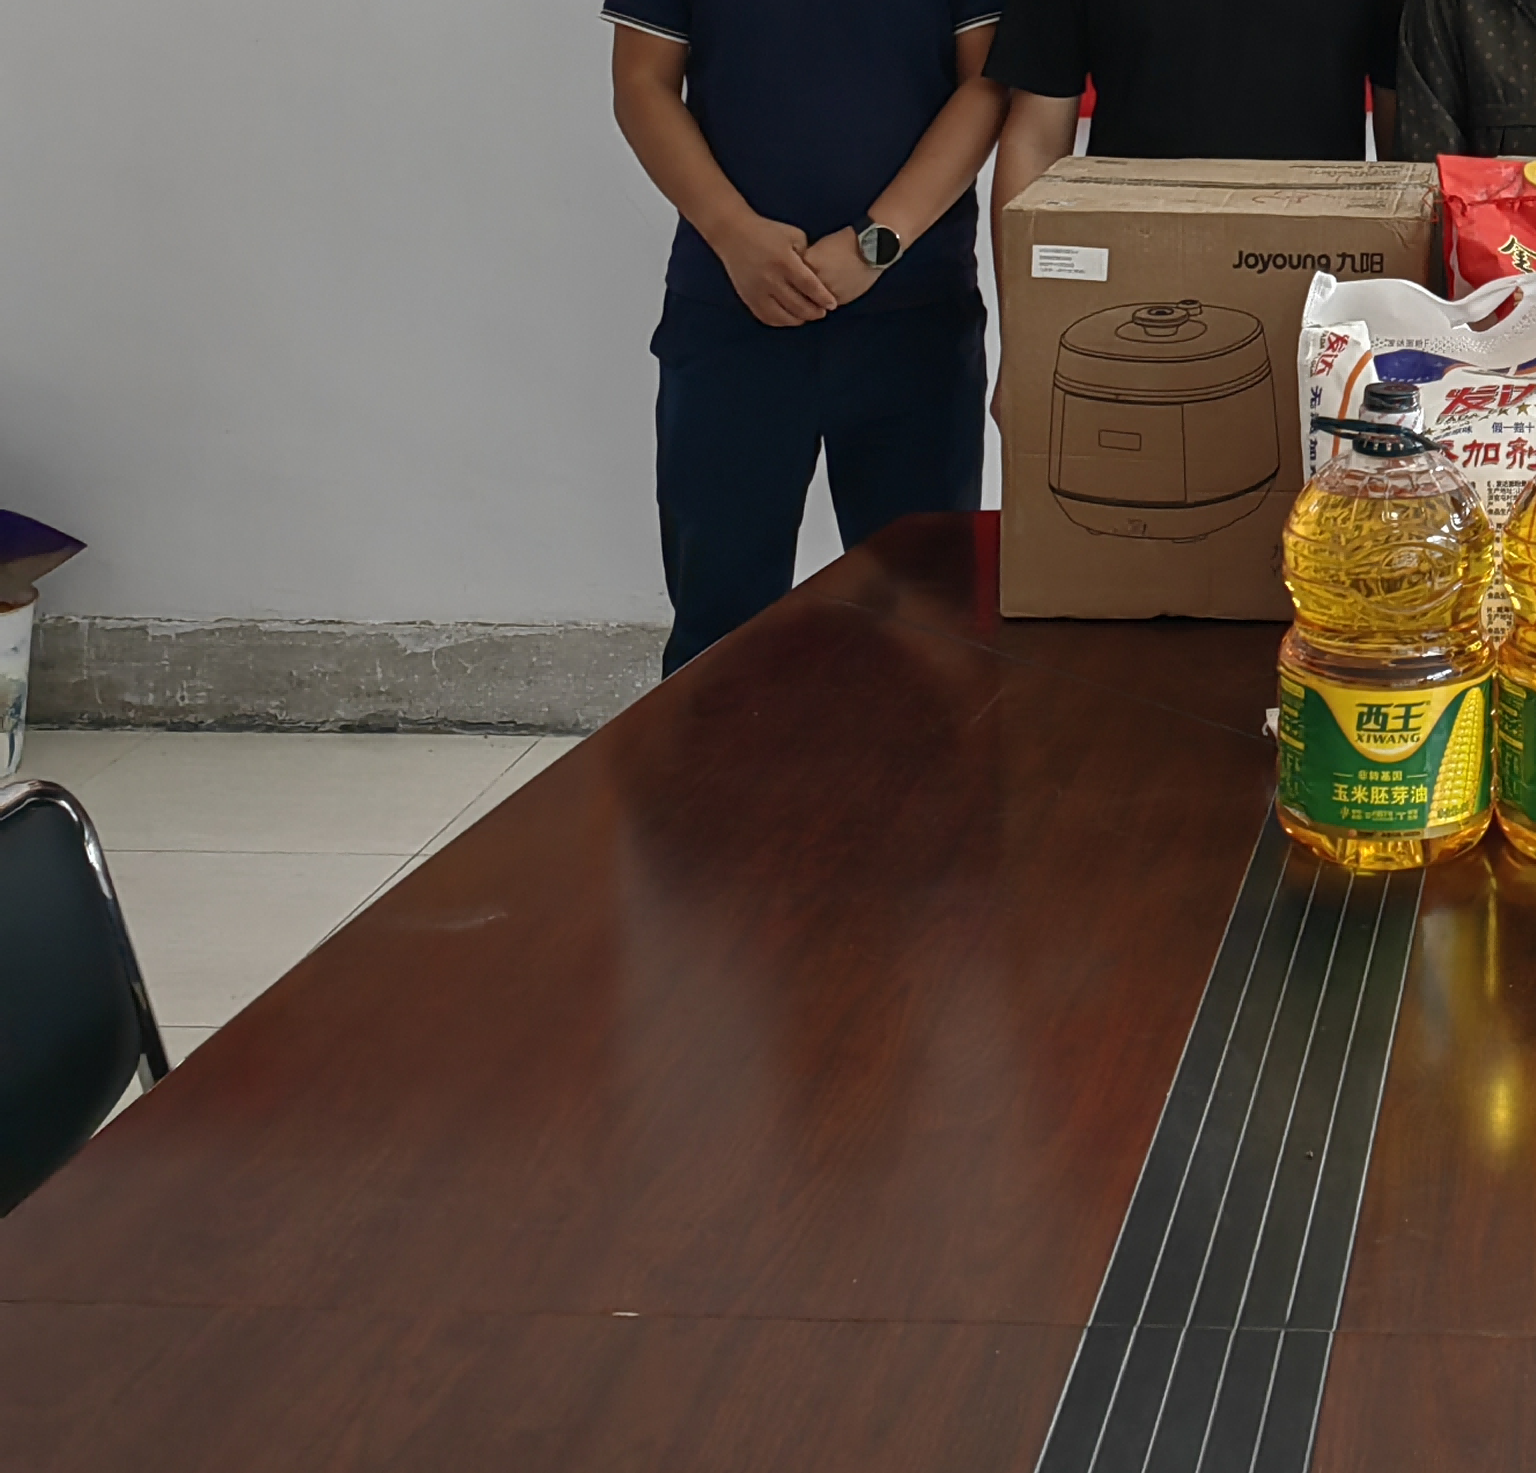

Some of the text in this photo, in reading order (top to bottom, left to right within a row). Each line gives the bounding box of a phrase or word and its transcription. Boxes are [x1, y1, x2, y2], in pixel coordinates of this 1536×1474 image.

[1232, 250, 1384, 274] Joyoung 九阳
[1355, 700, 1425, 732] 西王
[1355, 733, 1420, 744] XIWANG
[1358, 770, 1403, 782] 非转基因
[1332, 783, 1428, 805] 玉米胚芽油
